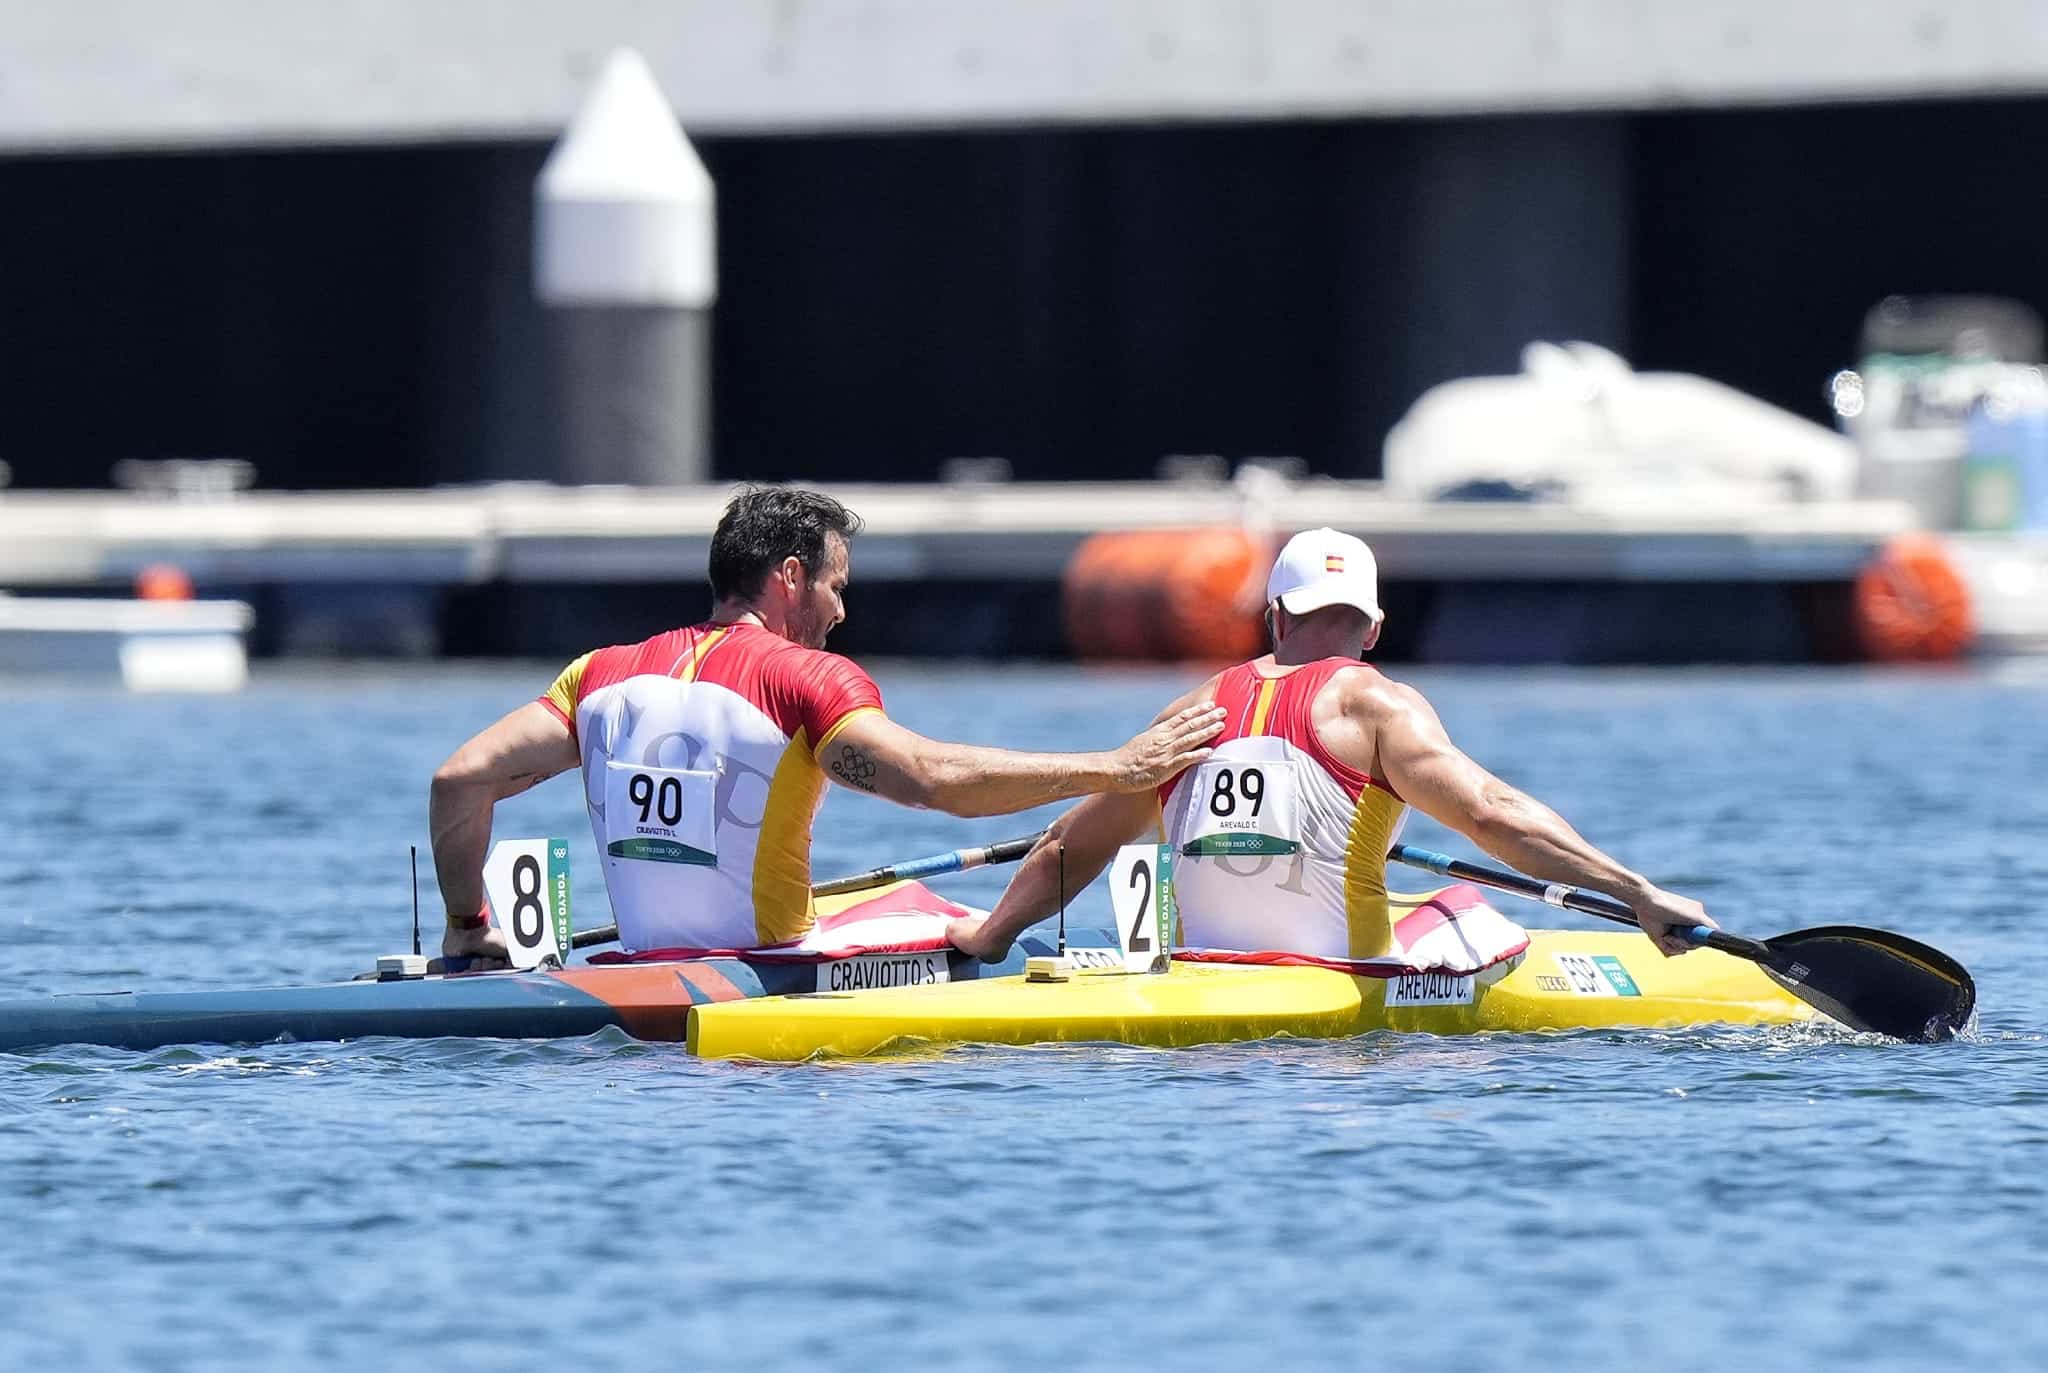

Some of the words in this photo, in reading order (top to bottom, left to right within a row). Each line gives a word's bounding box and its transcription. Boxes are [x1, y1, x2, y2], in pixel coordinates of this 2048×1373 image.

[629, 773, 682, 826] 90
[1210, 768, 1265, 817] 89
[512, 854, 544, 948] 8
[557, 872, 567, 916] TOKYO
[1128, 859, 1151, 953] 2
[1161, 877, 1169, 920] TOKYO
[558, 918, 568, 951] 2020
[1161, 924, 1169, 956] 2020
[831, 959, 921, 991] CRAVIOTTO
[1395, 973, 1452, 1001] AREVALO
